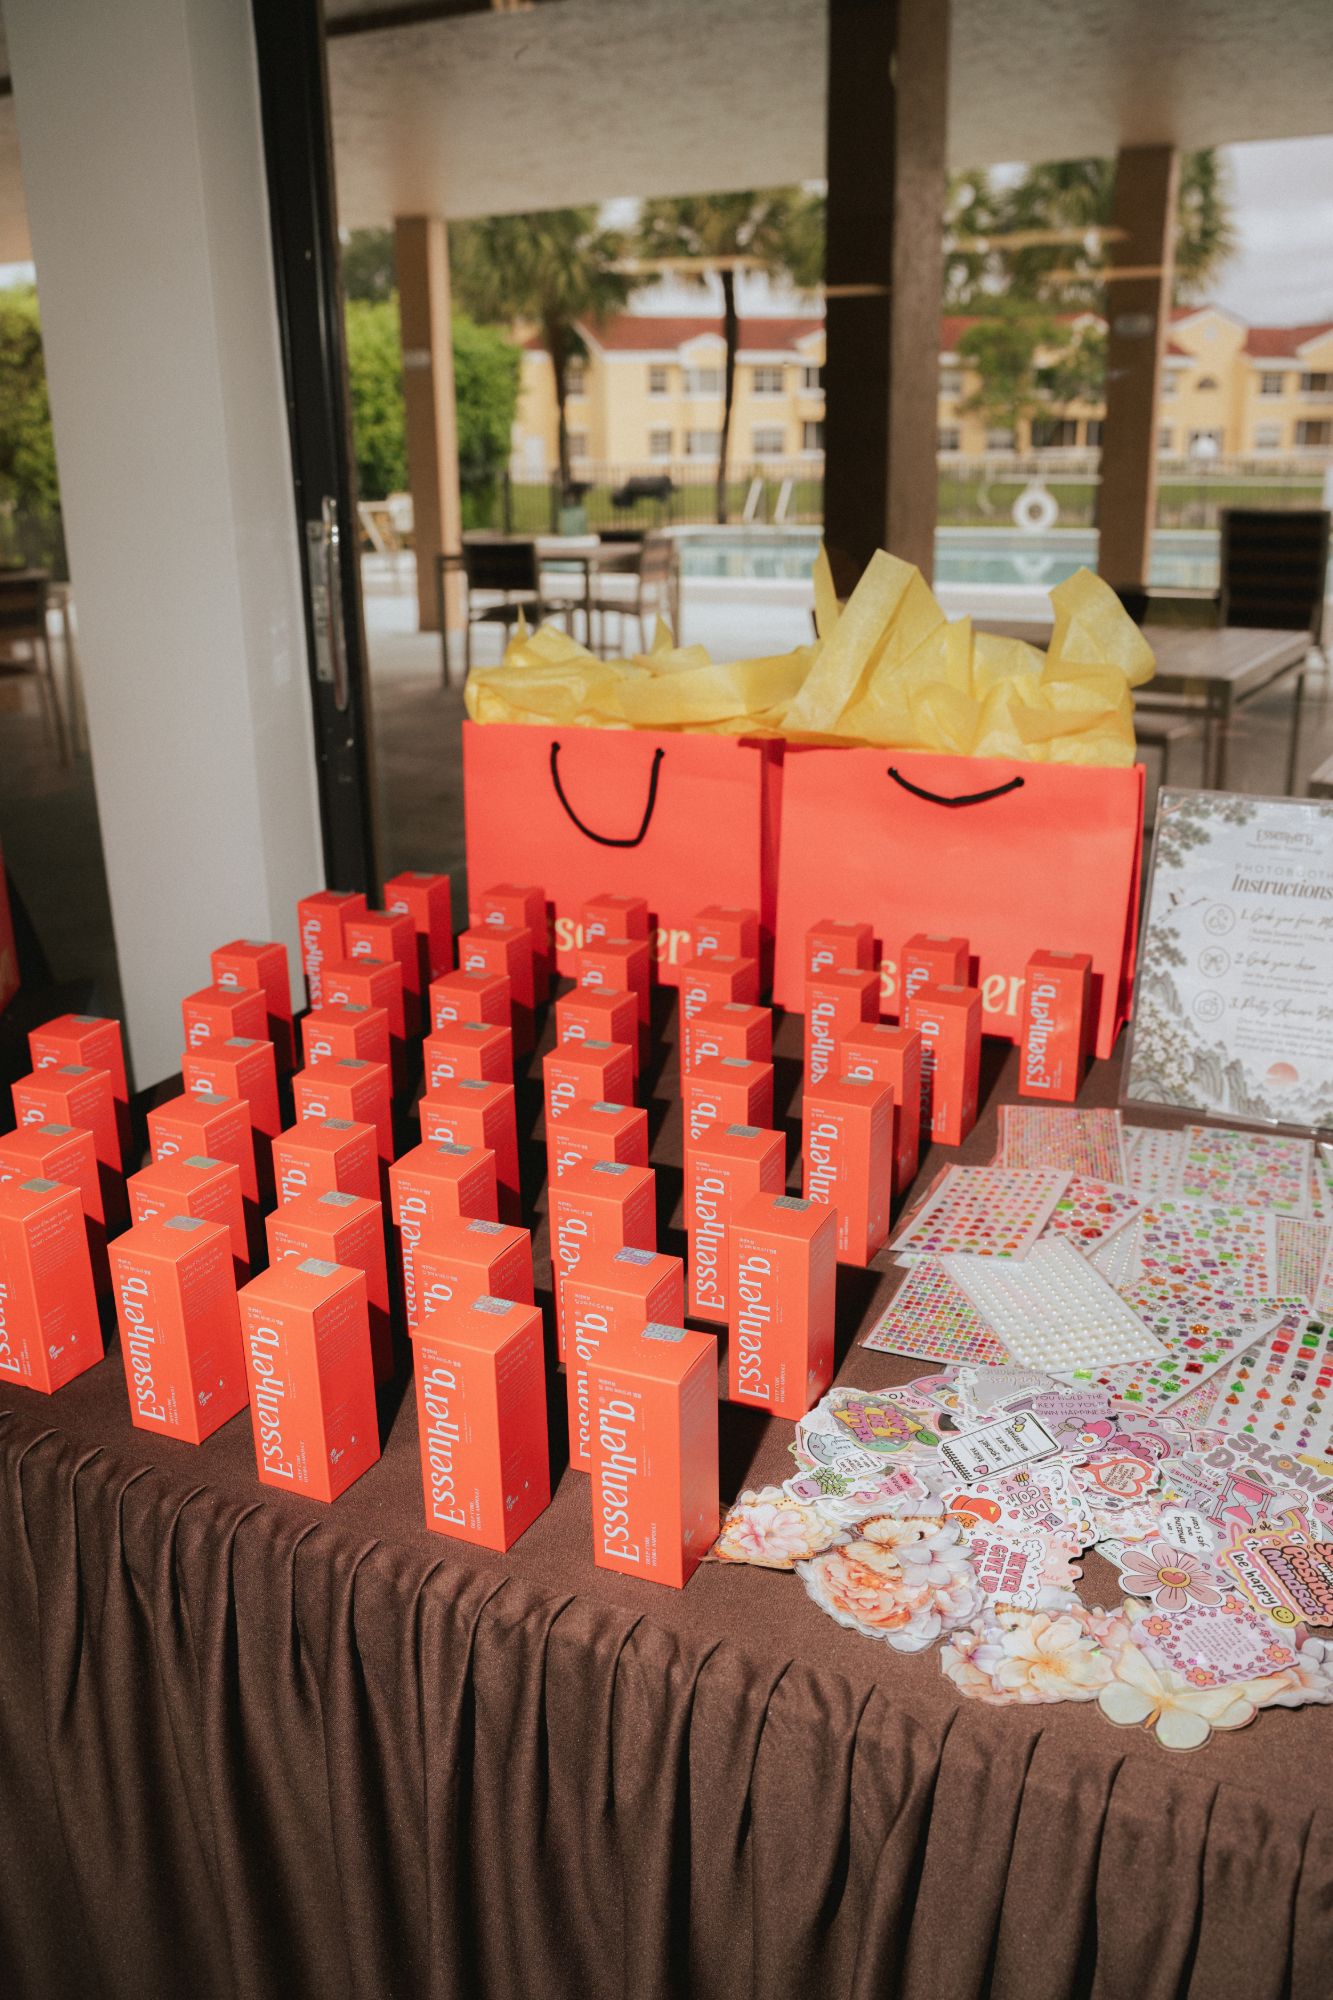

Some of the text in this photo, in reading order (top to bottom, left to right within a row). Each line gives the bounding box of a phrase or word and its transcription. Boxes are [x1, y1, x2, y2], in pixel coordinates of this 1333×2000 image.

[810, 1002, 836, 1085] senherb
[1025, 984, 1057, 1089] Essenherb
[809, 1122, 839, 1205] enherb
[696, 1177, 725, 1310] Essenherb
[119, 1276, 167, 1423] Essenherb
[738, 1256, 771, 1401] Essenherb
[249, 1326, 294, 1480] Essenherb
[423, 1367, 466, 1527] Essenherb
[599, 1399, 641, 1563] Essenherb
[979, 1544, 1008, 1593] GIVE UP
[1000, 1552, 1028, 1593] NEVER
[1232, 1553, 1249, 1568] be
[1245, 1569, 1279, 1605] happy
[1259, 1547, 1325, 1616] Mindset
